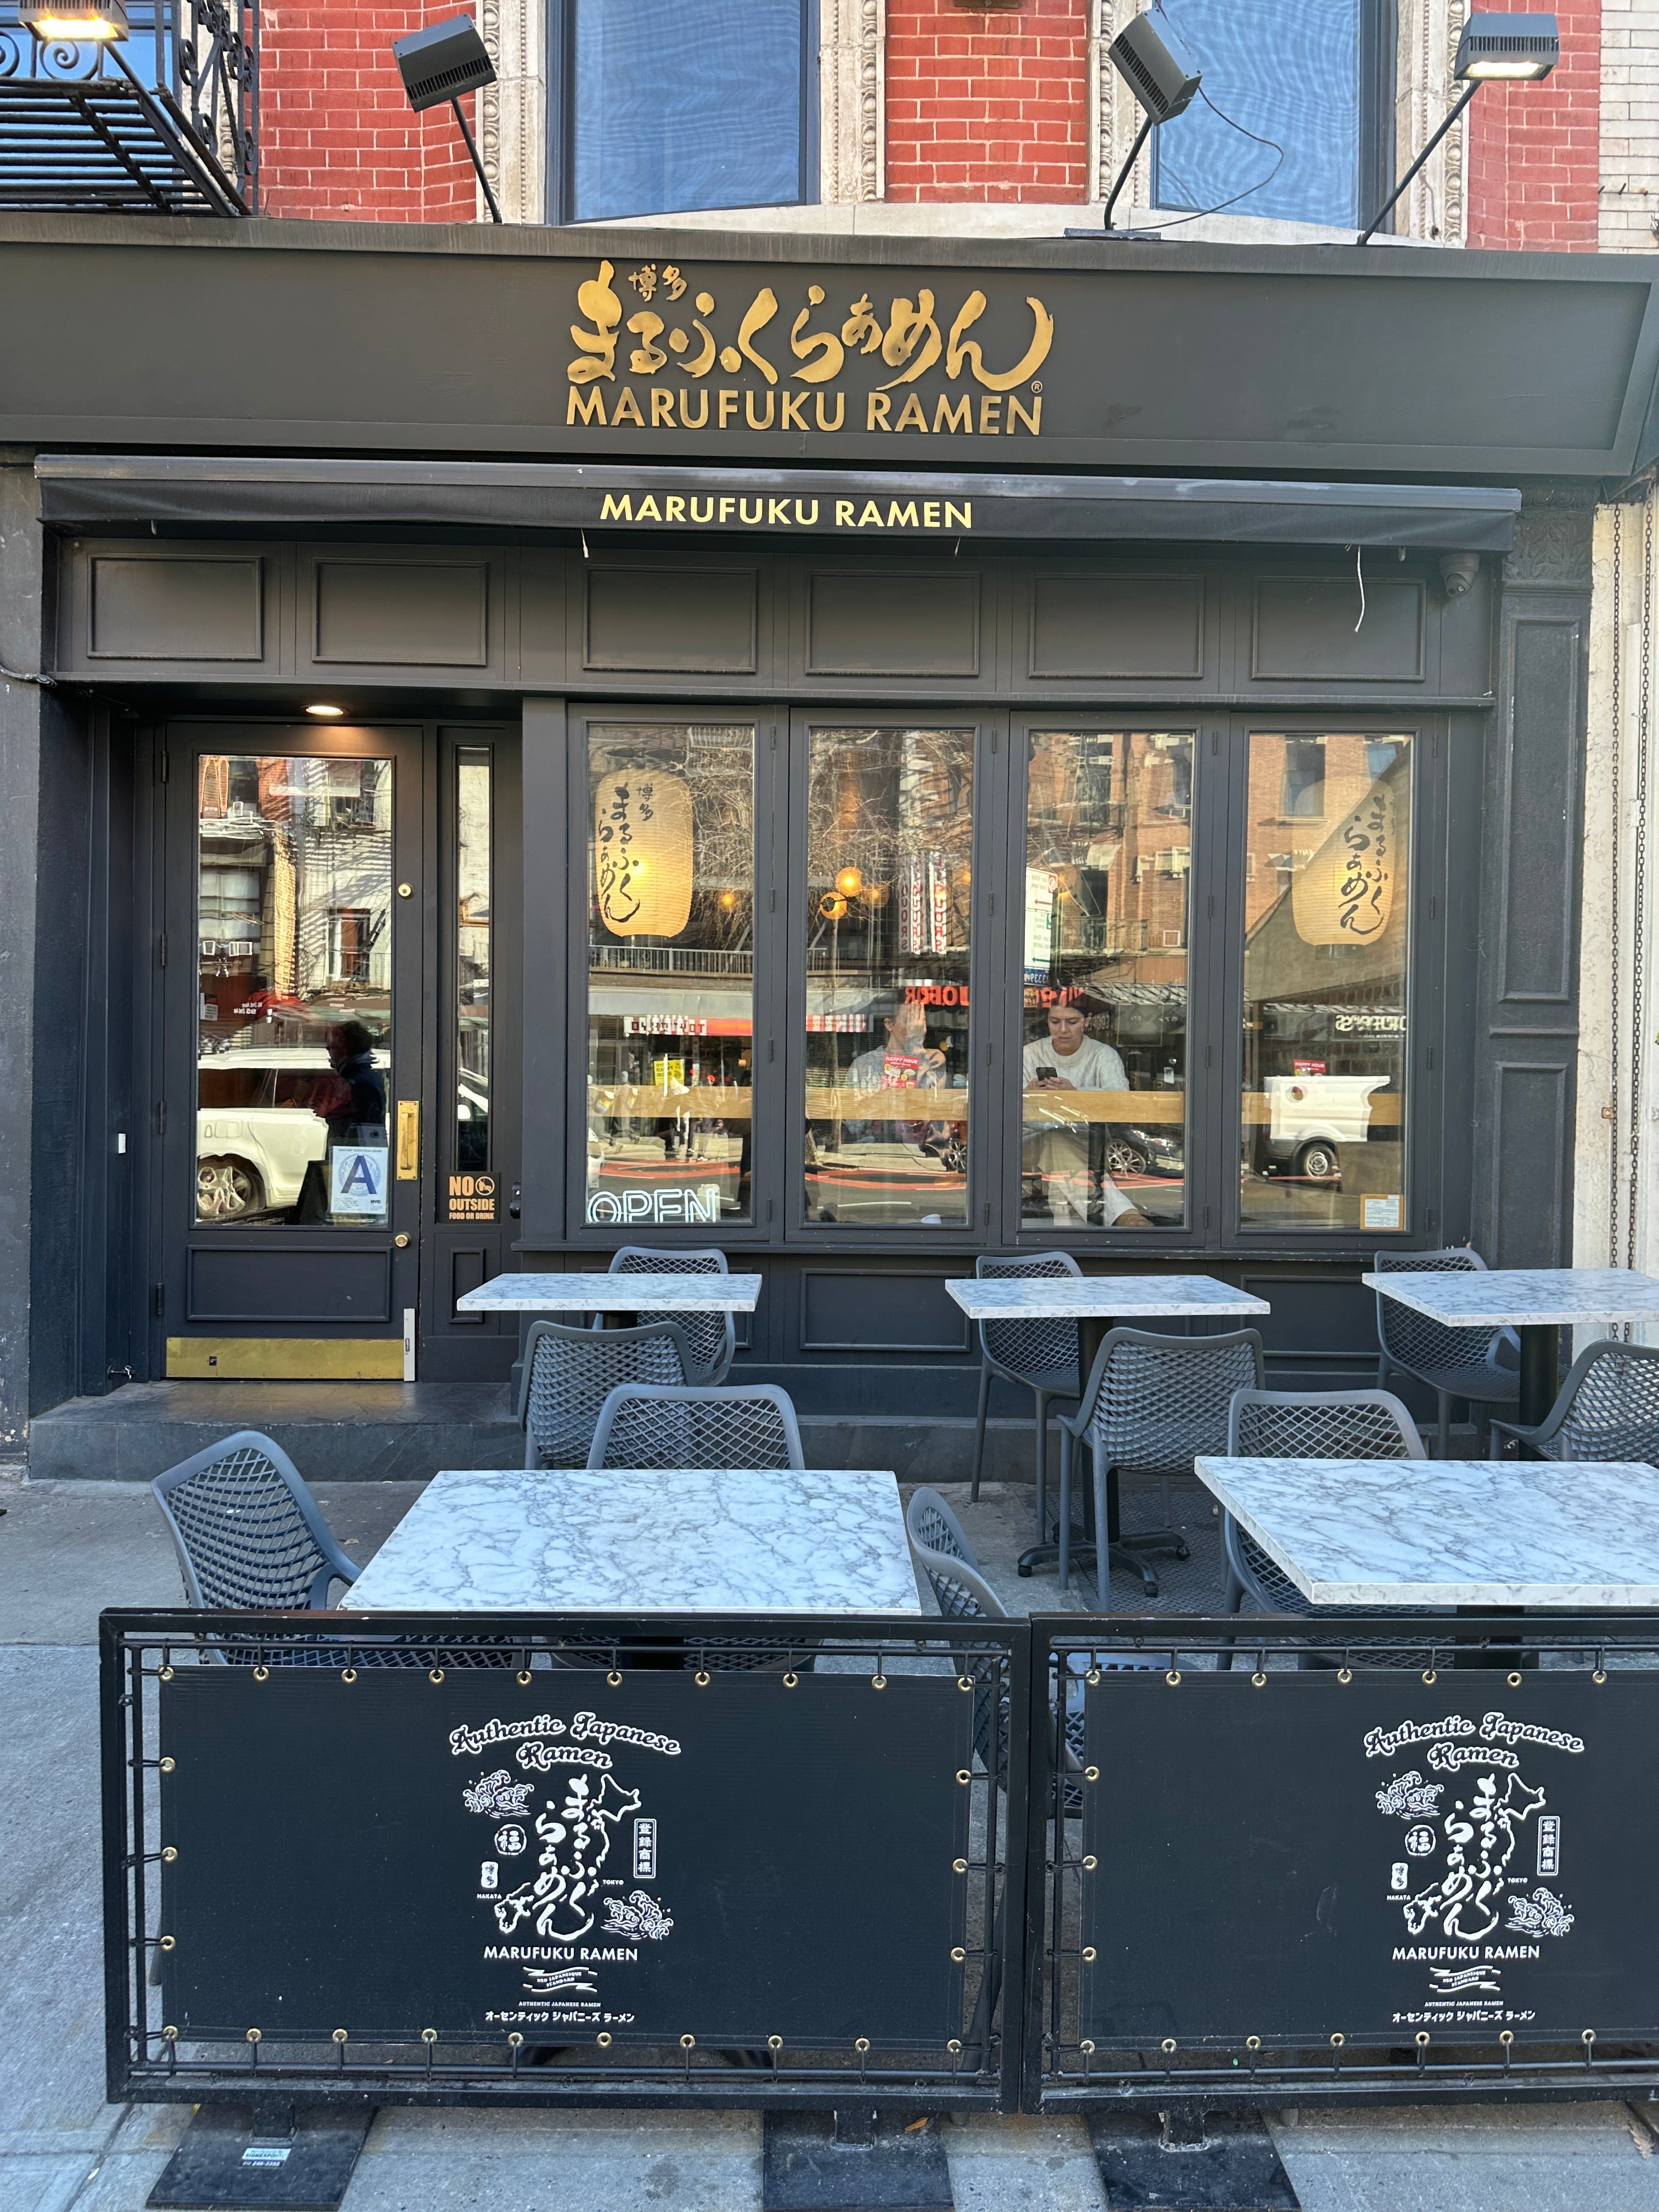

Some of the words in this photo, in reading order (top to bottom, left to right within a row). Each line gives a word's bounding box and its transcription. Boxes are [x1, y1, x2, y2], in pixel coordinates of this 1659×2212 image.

[628, 264, 688, 301] 博多
[567, 386, 845, 431] MARUFUKU
[867, 392, 1043, 435] RAMEN
[600, 494, 819, 525] MARUFUKU
[836, 501, 972, 528] RAMEN
[636, 783, 654, 821] 博多
[341, 1155, 377, 1194] A
[449, 1176, 474, 1196] NO
[449, 1198, 495, 1211] OUTSIDE
[450, 1714, 566, 1755] Authentic
[569, 1711, 681, 1755] Japanese
[1363, 1715, 1476, 1757] Authentic
[1479, 1712, 1584, 1752] Japanese
[516, 1741, 613, 1771] Ramen
[1427, 1742, 1519, 1771] Ramen
[496, 1829, 523, 1852] 福
[1407, 1830, 1432, 1853] 福
[484, 1946, 574, 1960] MARUFUKU
[580, 1948, 637, 1961] RAMEN
[1392, 1946, 1480, 1960] MARUFUKU
[1485, 1945, 1540, 1959] RAMEN
[546, 1977, 575, 1987] STANDARD
[1451, 1976, 1479, 1987] STANDARD
[486, 2011, 549, 2022] オーセンティック
[552, 2011, 601, 2022] ジャパニーズ
[604, 2013, 635, 2023] ラーメン
[1393, 2011, 1454, 2023] オーセンティック
[1457, 2010, 1504, 2022] ジャパニーズ
[1506, 2010, 1536, 2021] ラーメン
